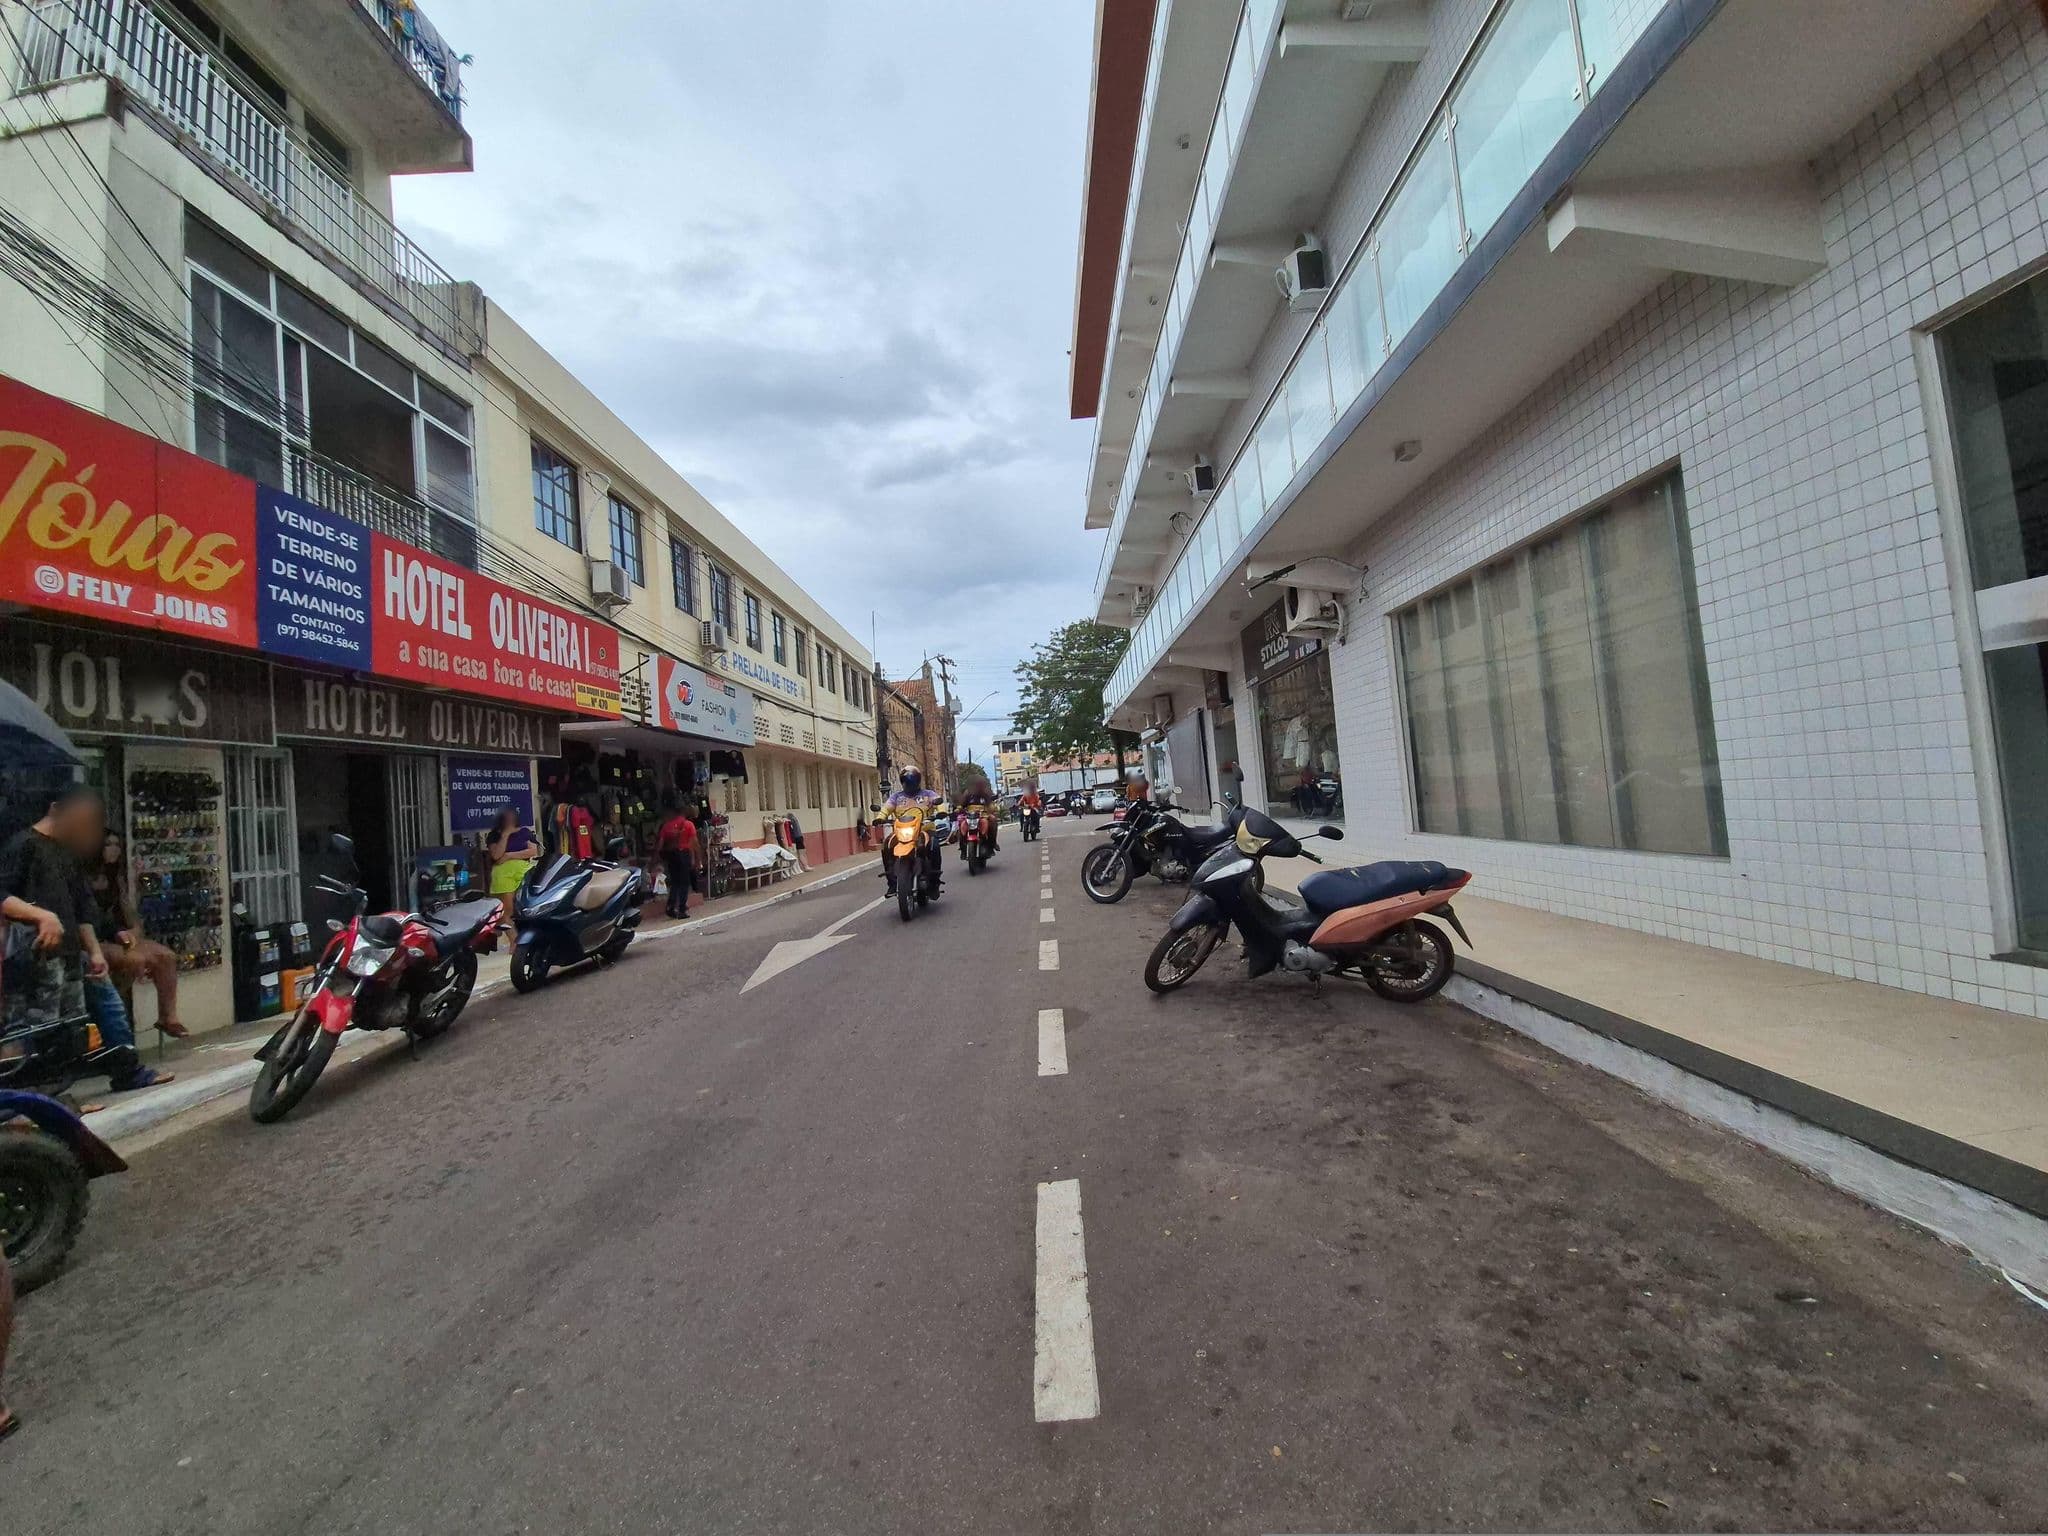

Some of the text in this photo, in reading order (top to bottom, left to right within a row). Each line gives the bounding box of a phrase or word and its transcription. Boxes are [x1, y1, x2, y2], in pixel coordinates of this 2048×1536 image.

[274, 506, 359, 551] VENDE-SE
[277, 533, 357, 574] TERRENO
[272, 558, 362, 599] DE VÁRIOS
[268, 584, 365, 624] TAMANHOS
[384, 549, 472, 640] HOTEL
[490, 592, 581, 671] OLIVEIRA
[277, 623, 360, 651] (97) 98452-5845
[291, 613, 346, 635] CONTATO:
[1261, 632, 1289, 662] STYLOS
[399, 640, 575, 699] a sua casa fora de casa!
[733, 651, 770, 685] PRELAZIA
[771, 671, 781, 689] DE
[304, 679, 406, 739] HOTEL
[430, 700, 532, 750] OLIVEIRA
[702, 700, 727, 717] FASHION
[452, 782, 463, 790] DE
[493, 782, 529, 791] TAMANHOS
[456, 768, 525, 779] VENDE-SE TERRENO
[467, 808, 482, 818] (97)
[476, 795, 511, 803] CONTATO:
